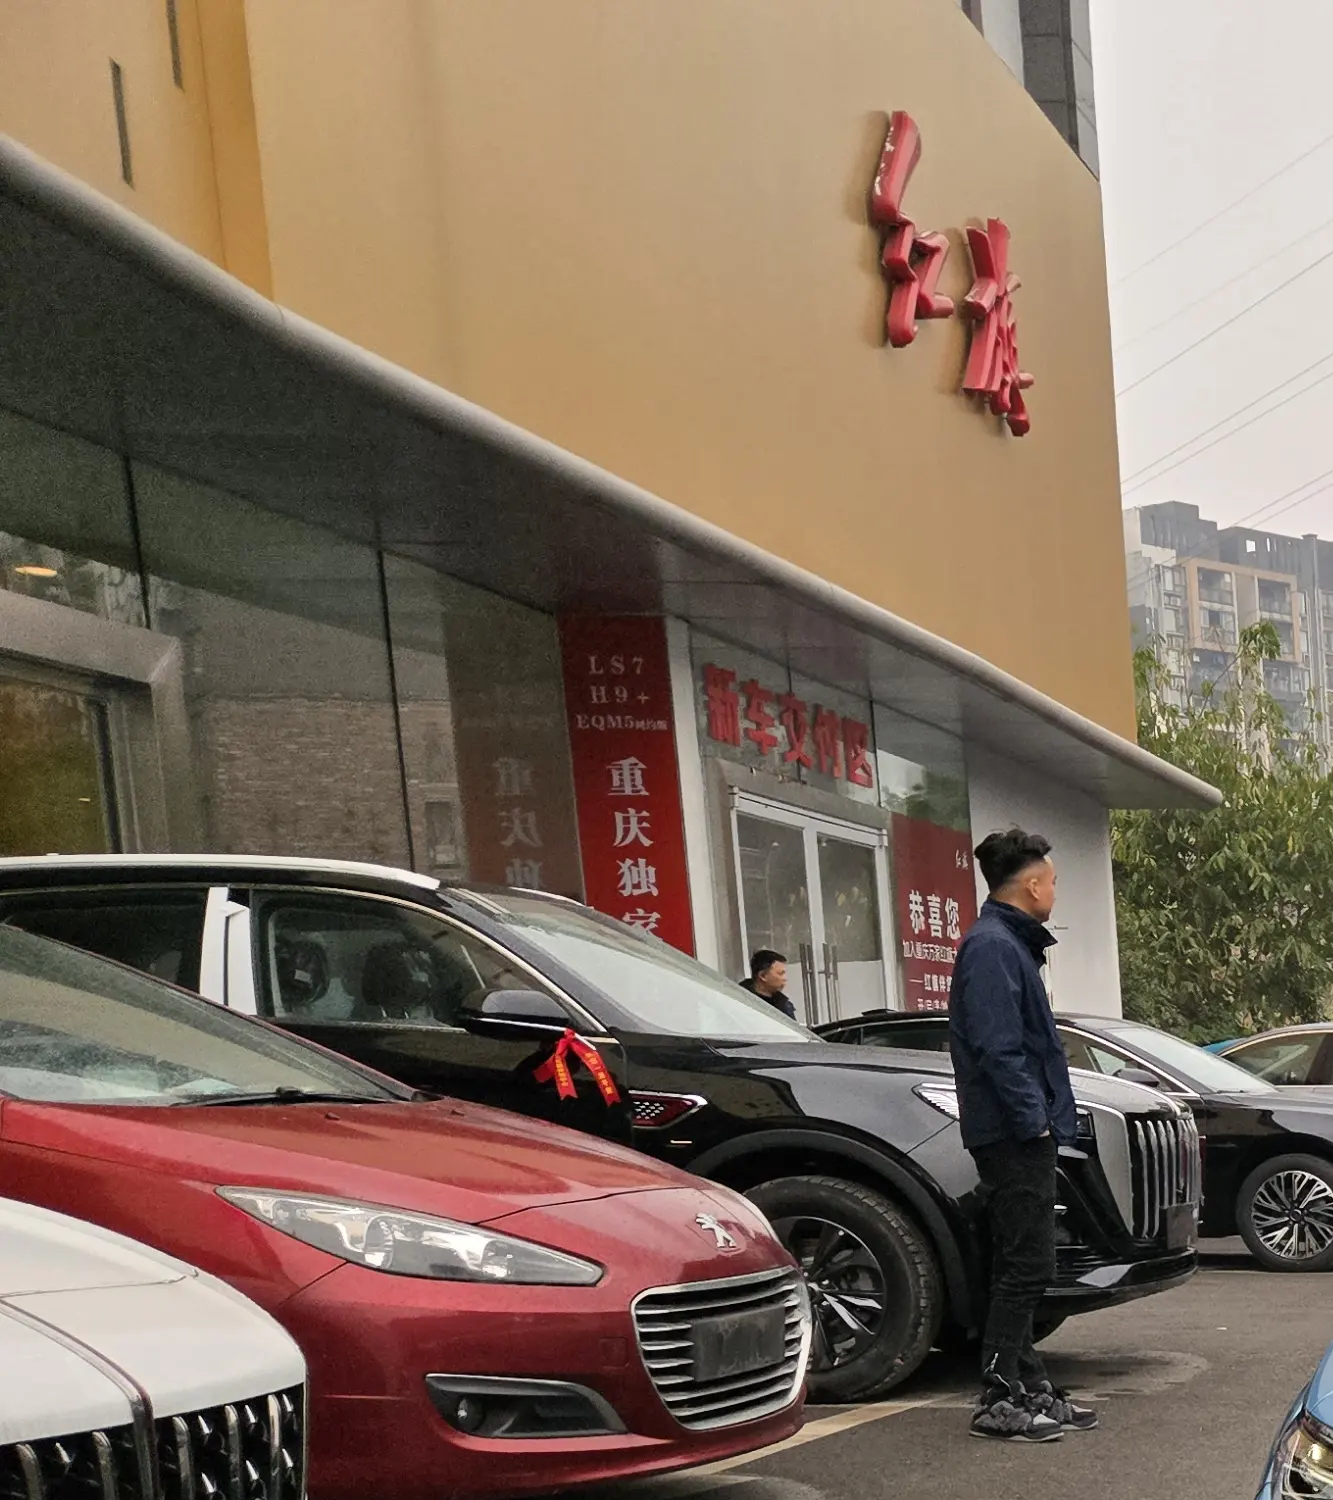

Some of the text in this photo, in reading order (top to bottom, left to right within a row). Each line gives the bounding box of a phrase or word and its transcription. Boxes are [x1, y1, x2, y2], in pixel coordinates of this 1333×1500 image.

[872, 110, 1034, 437] 红旗
[704, 663, 873, 788] 新车交付区
[908, 889, 961, 940] 恭喜您
